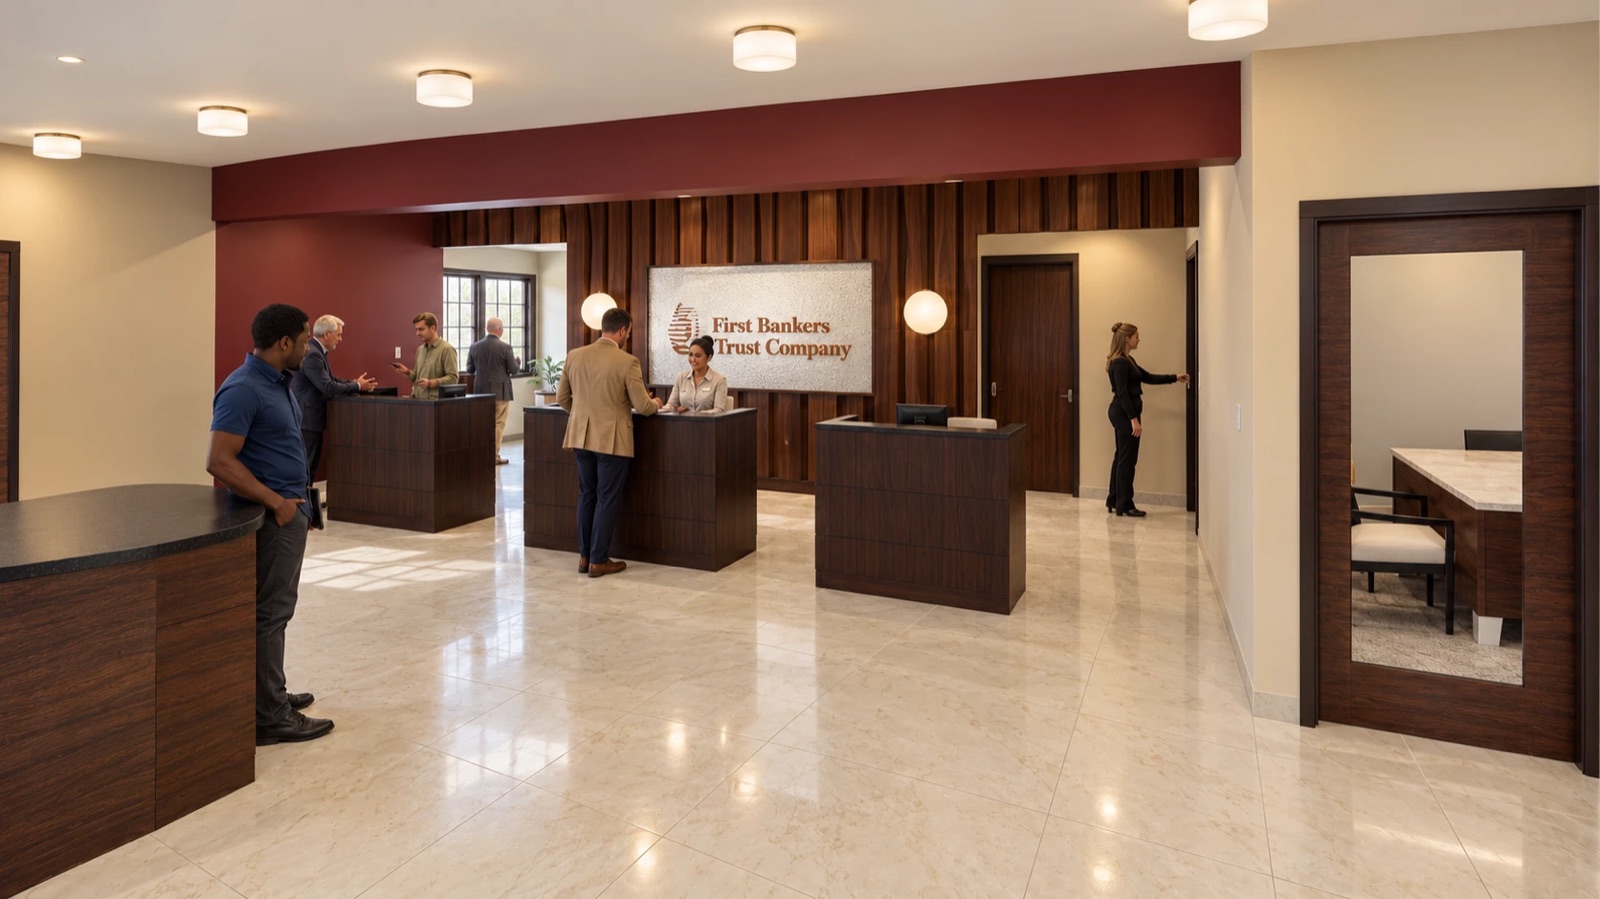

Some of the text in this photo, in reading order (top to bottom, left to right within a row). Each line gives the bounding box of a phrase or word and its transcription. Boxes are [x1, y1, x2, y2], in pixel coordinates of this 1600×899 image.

[712, 316, 831, 334] First Bankers
[715, 338, 852, 361] Trust Company
